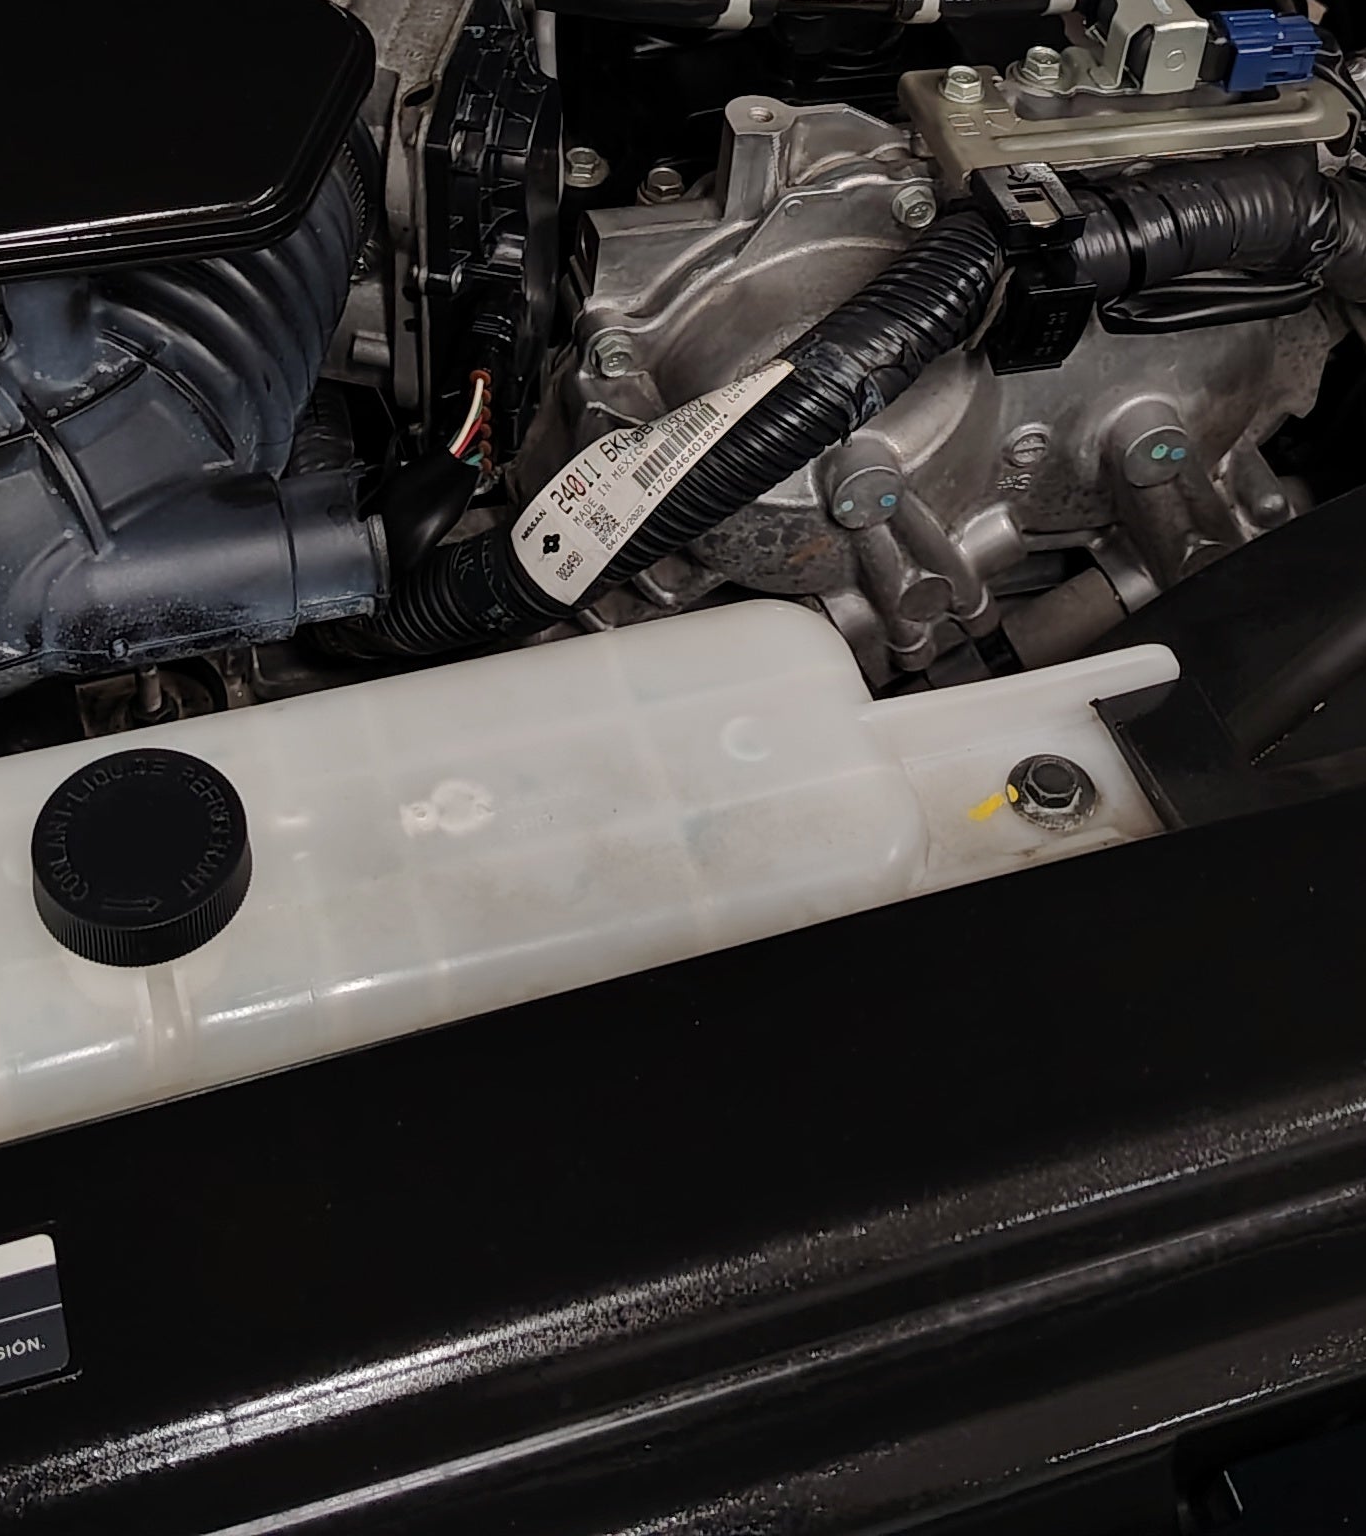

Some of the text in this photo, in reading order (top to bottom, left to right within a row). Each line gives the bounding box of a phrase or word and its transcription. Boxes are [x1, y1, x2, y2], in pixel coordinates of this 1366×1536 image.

[550, 458, 601, 515] 24011
[573, 441, 649, 526] MADE IN MEXICO
[521, 508, 547, 542] NISSAN
